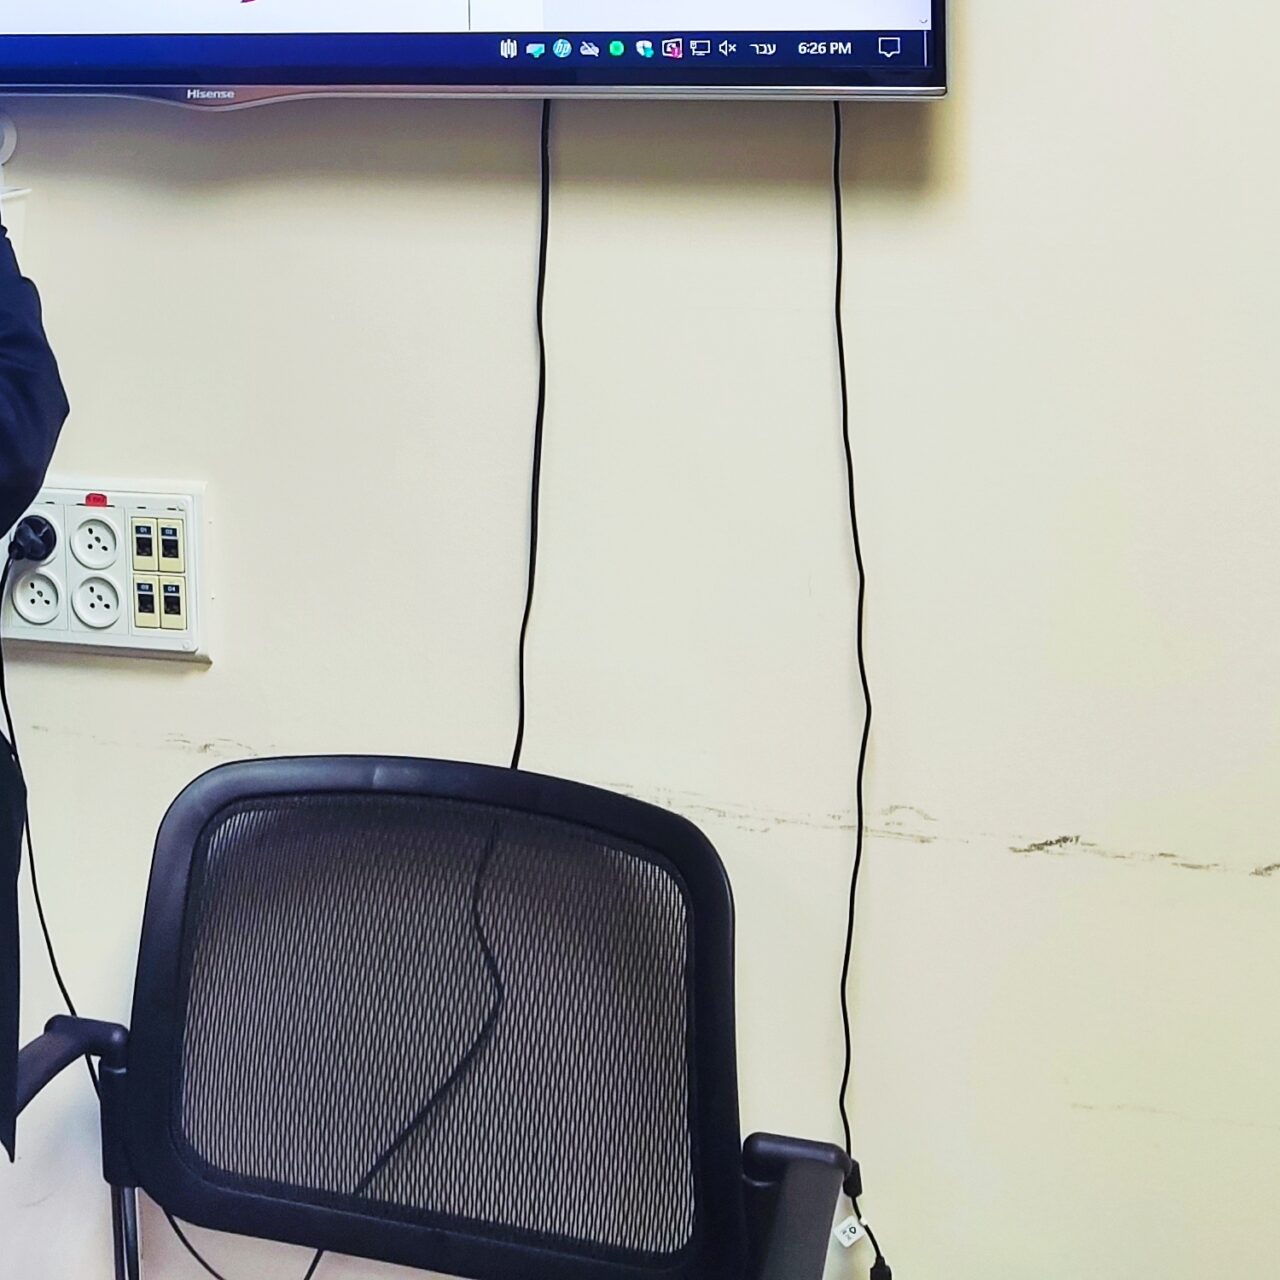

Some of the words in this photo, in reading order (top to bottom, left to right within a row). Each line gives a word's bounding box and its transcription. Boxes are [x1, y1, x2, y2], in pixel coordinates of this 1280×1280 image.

[798, 41, 826, 55] 6:26
[829, 41, 852, 55] PM
[187, 89, 235, 99] Hisense
